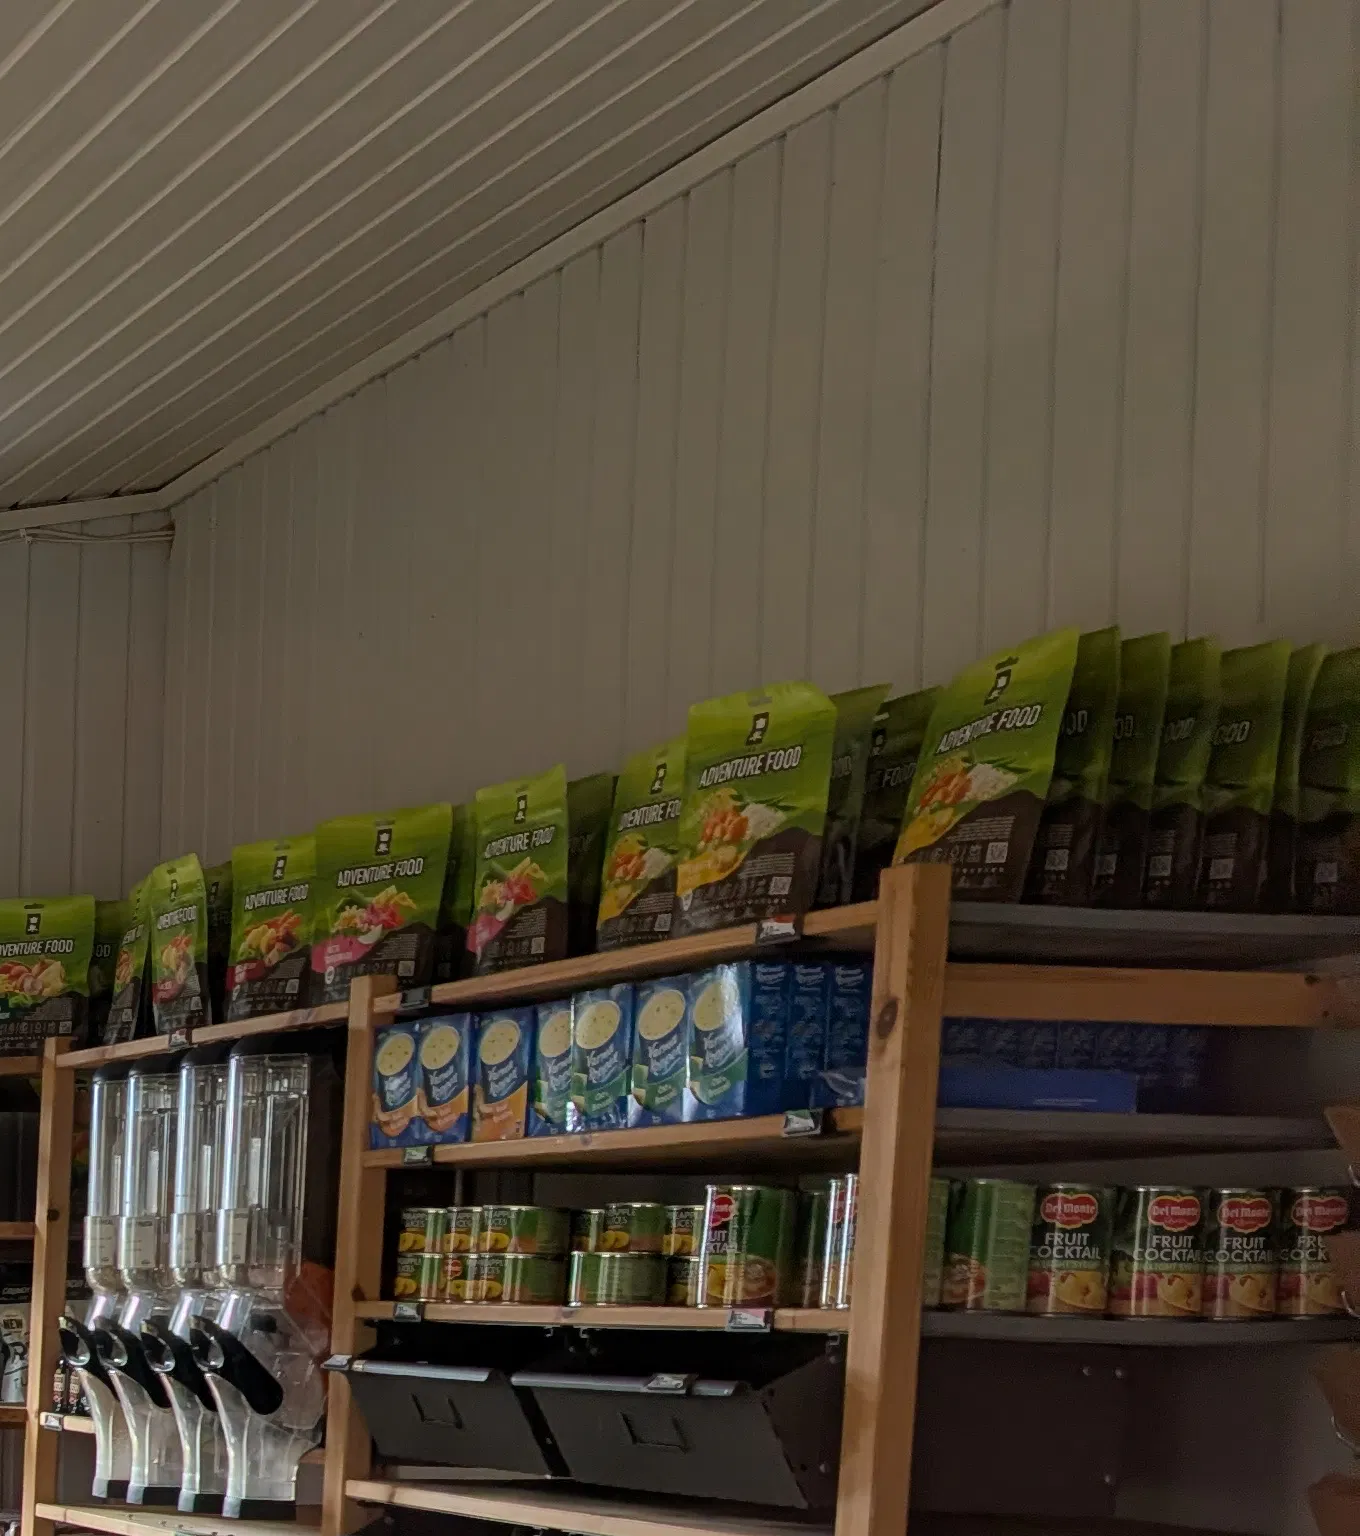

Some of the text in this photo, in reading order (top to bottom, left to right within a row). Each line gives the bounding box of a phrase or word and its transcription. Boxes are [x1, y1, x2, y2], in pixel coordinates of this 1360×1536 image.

[936, 717, 997, 753] ADVENTURE
[999, 704, 1041, 730] FOOD
[701, 746, 802, 787] ADVENTURE FOOD
[337, 858, 425, 886] ADVENTURE FOOD
[44, 939, 74, 954] FOOD
[1044, 1232, 1090, 1245] FRUIT
[1151, 1235, 1196, 1248] FRUIT
[1223, 1237, 1268, 1250] FRUIT
[1281, 1247, 1328, 1261] COCK
